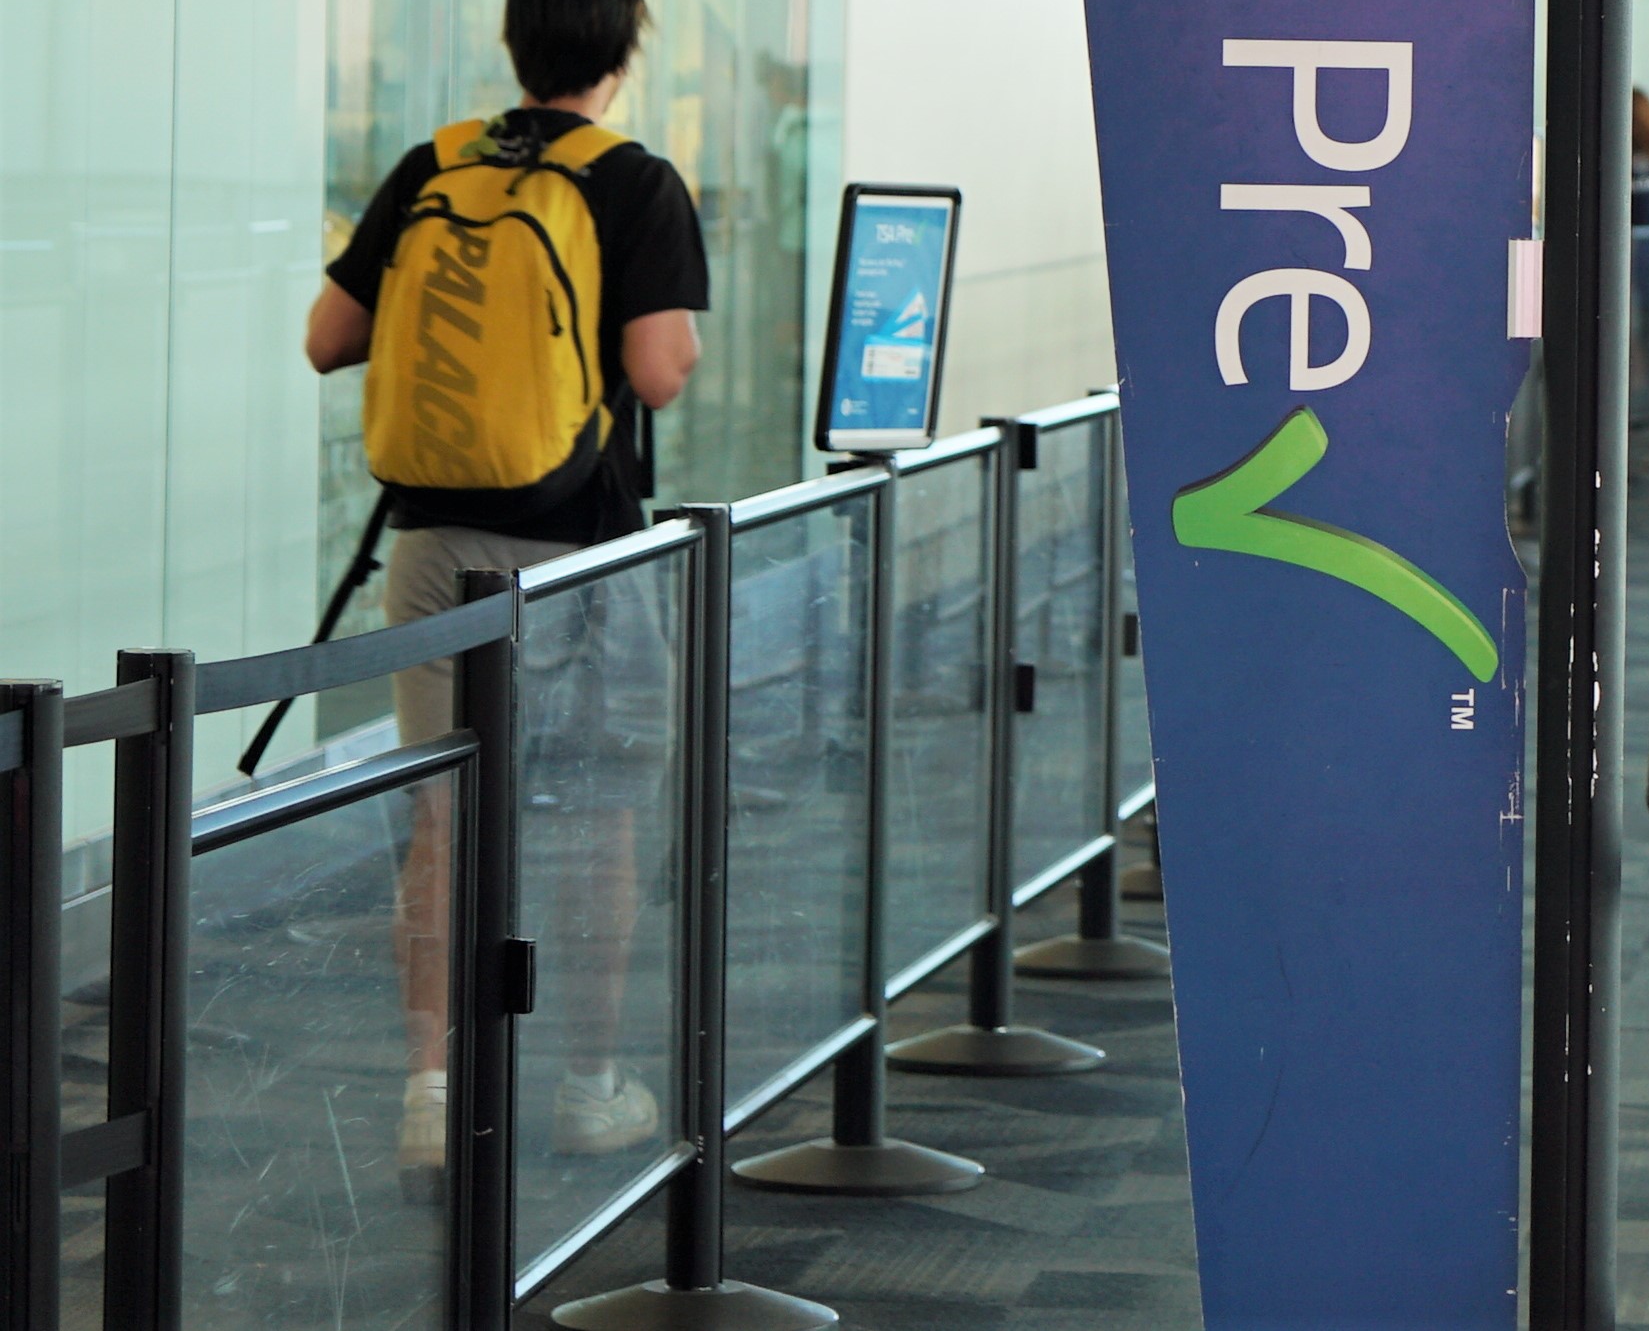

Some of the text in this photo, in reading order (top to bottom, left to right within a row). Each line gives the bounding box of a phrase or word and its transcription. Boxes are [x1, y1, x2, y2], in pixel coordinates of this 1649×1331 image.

[1214, 38, 1413, 392] Pre
[412, 221, 492, 480] PALACE
[1450, 687, 1475, 730] TM
